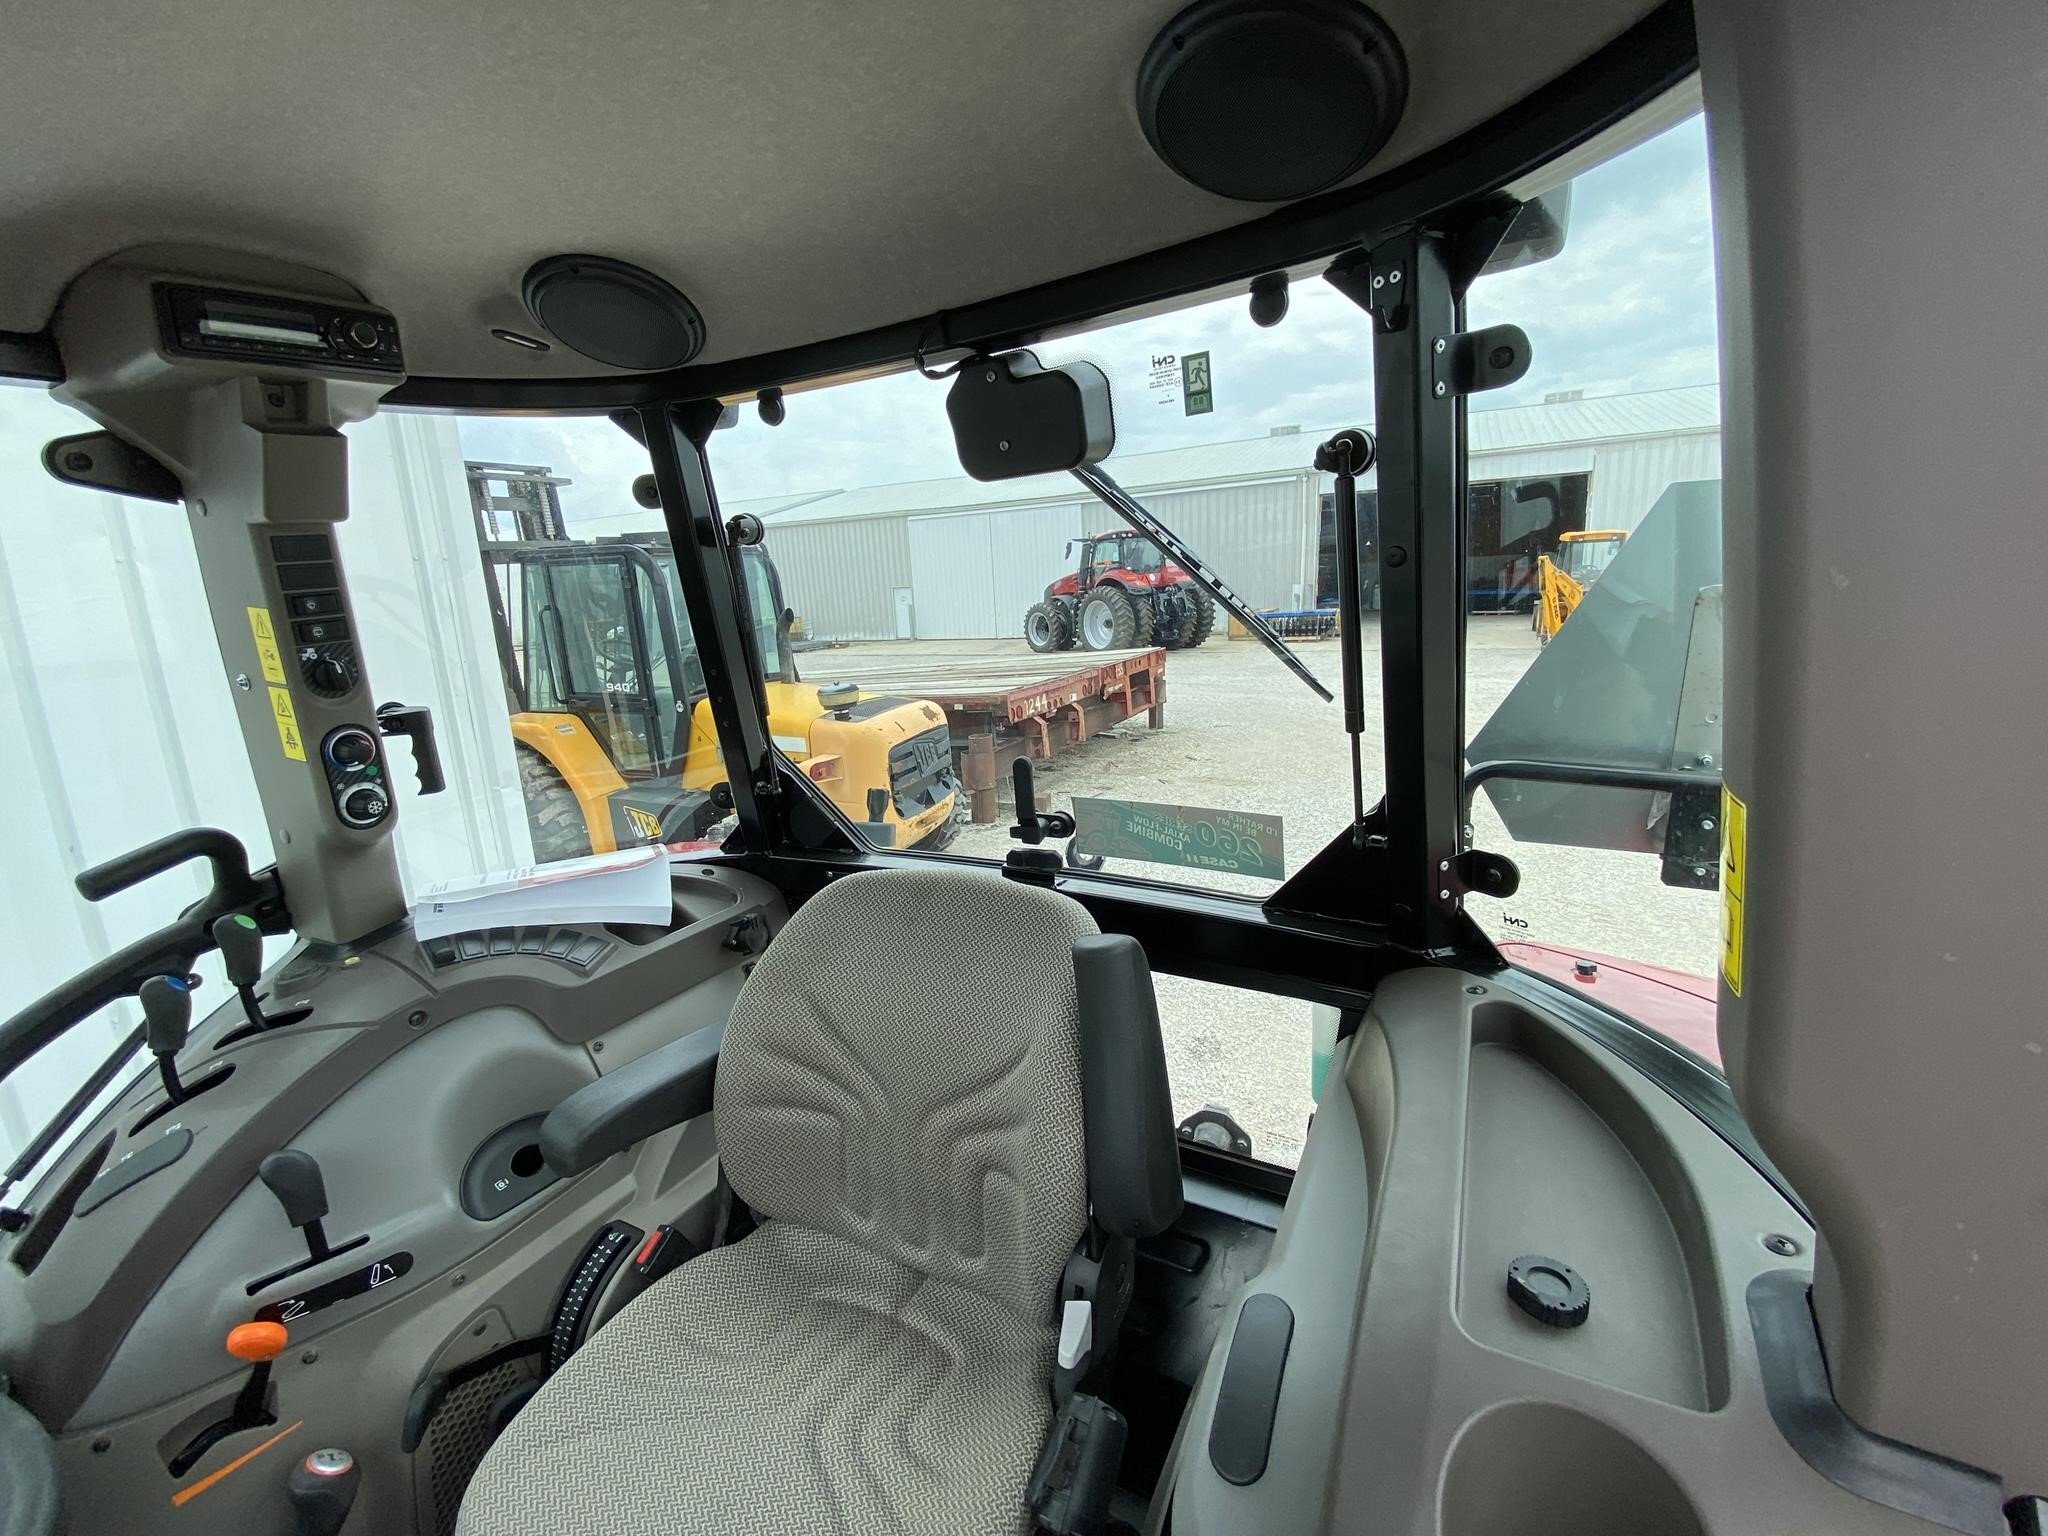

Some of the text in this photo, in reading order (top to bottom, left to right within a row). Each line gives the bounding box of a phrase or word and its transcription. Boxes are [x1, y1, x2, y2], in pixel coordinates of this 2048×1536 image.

[606, 682, 630, 692] 940
[1024, 693, 1048, 715] 1244
[630, 810, 660, 838] JCB
